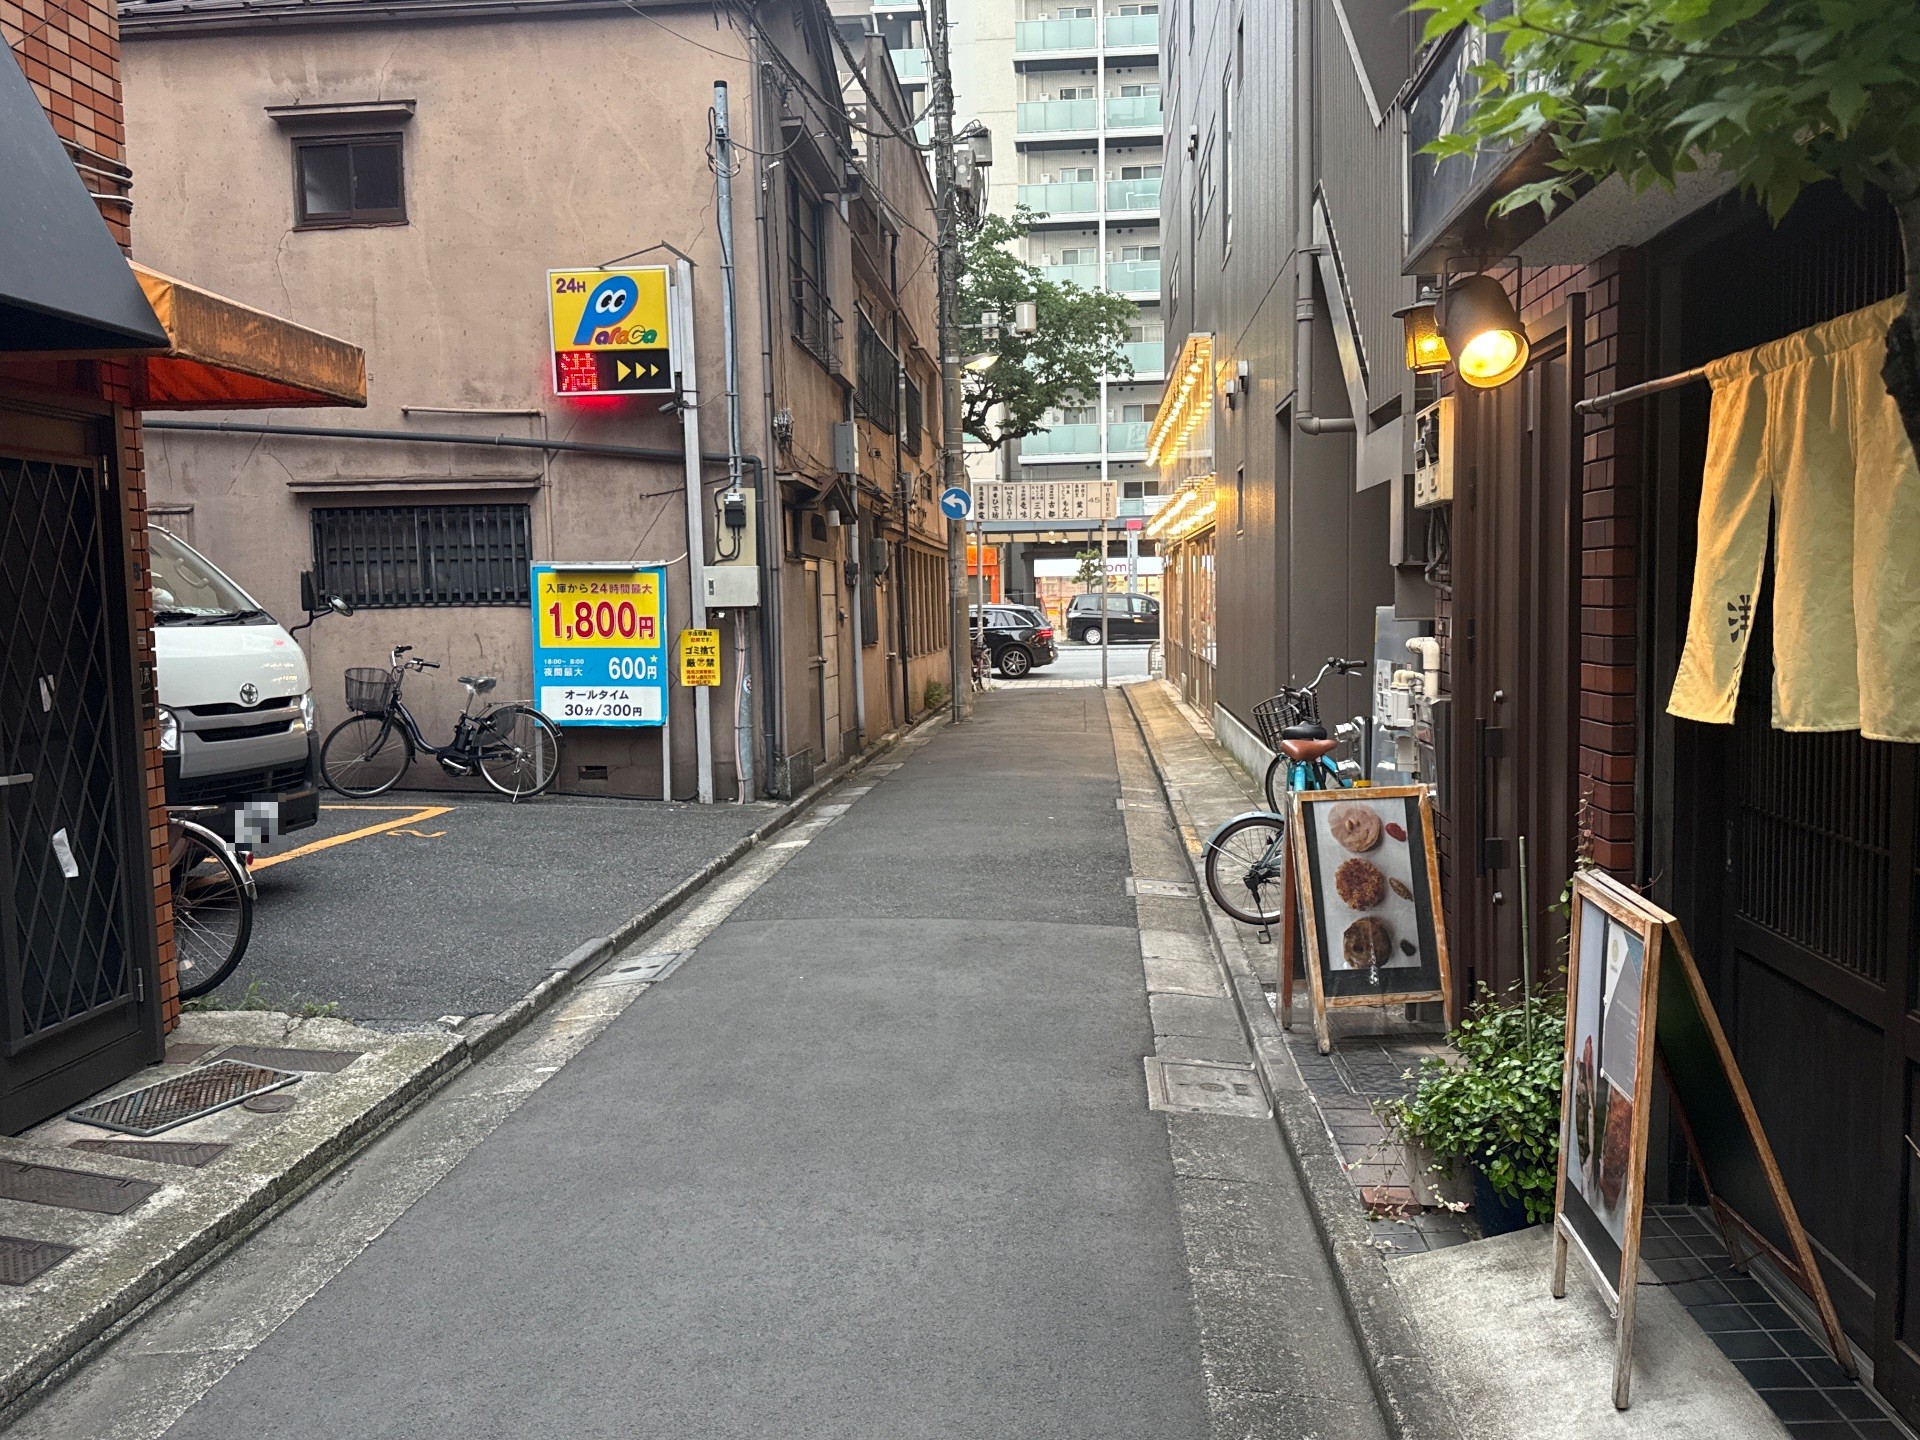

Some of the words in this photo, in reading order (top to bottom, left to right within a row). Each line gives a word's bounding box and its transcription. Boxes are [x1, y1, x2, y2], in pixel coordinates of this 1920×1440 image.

[555, 277, 586, 294] 24H
[545, 582, 653, 595] 入庫から24時間最大
[548, 601, 656, 641] 1,800円
[685, 645, 716, 656] ゴミ捨て
[543, 667, 584, 677] 夜間最大
[608, 656, 658, 680] 600円
[564, 689, 630, 700] オールタイム
[564, 703, 643, 718] 30分/300円
